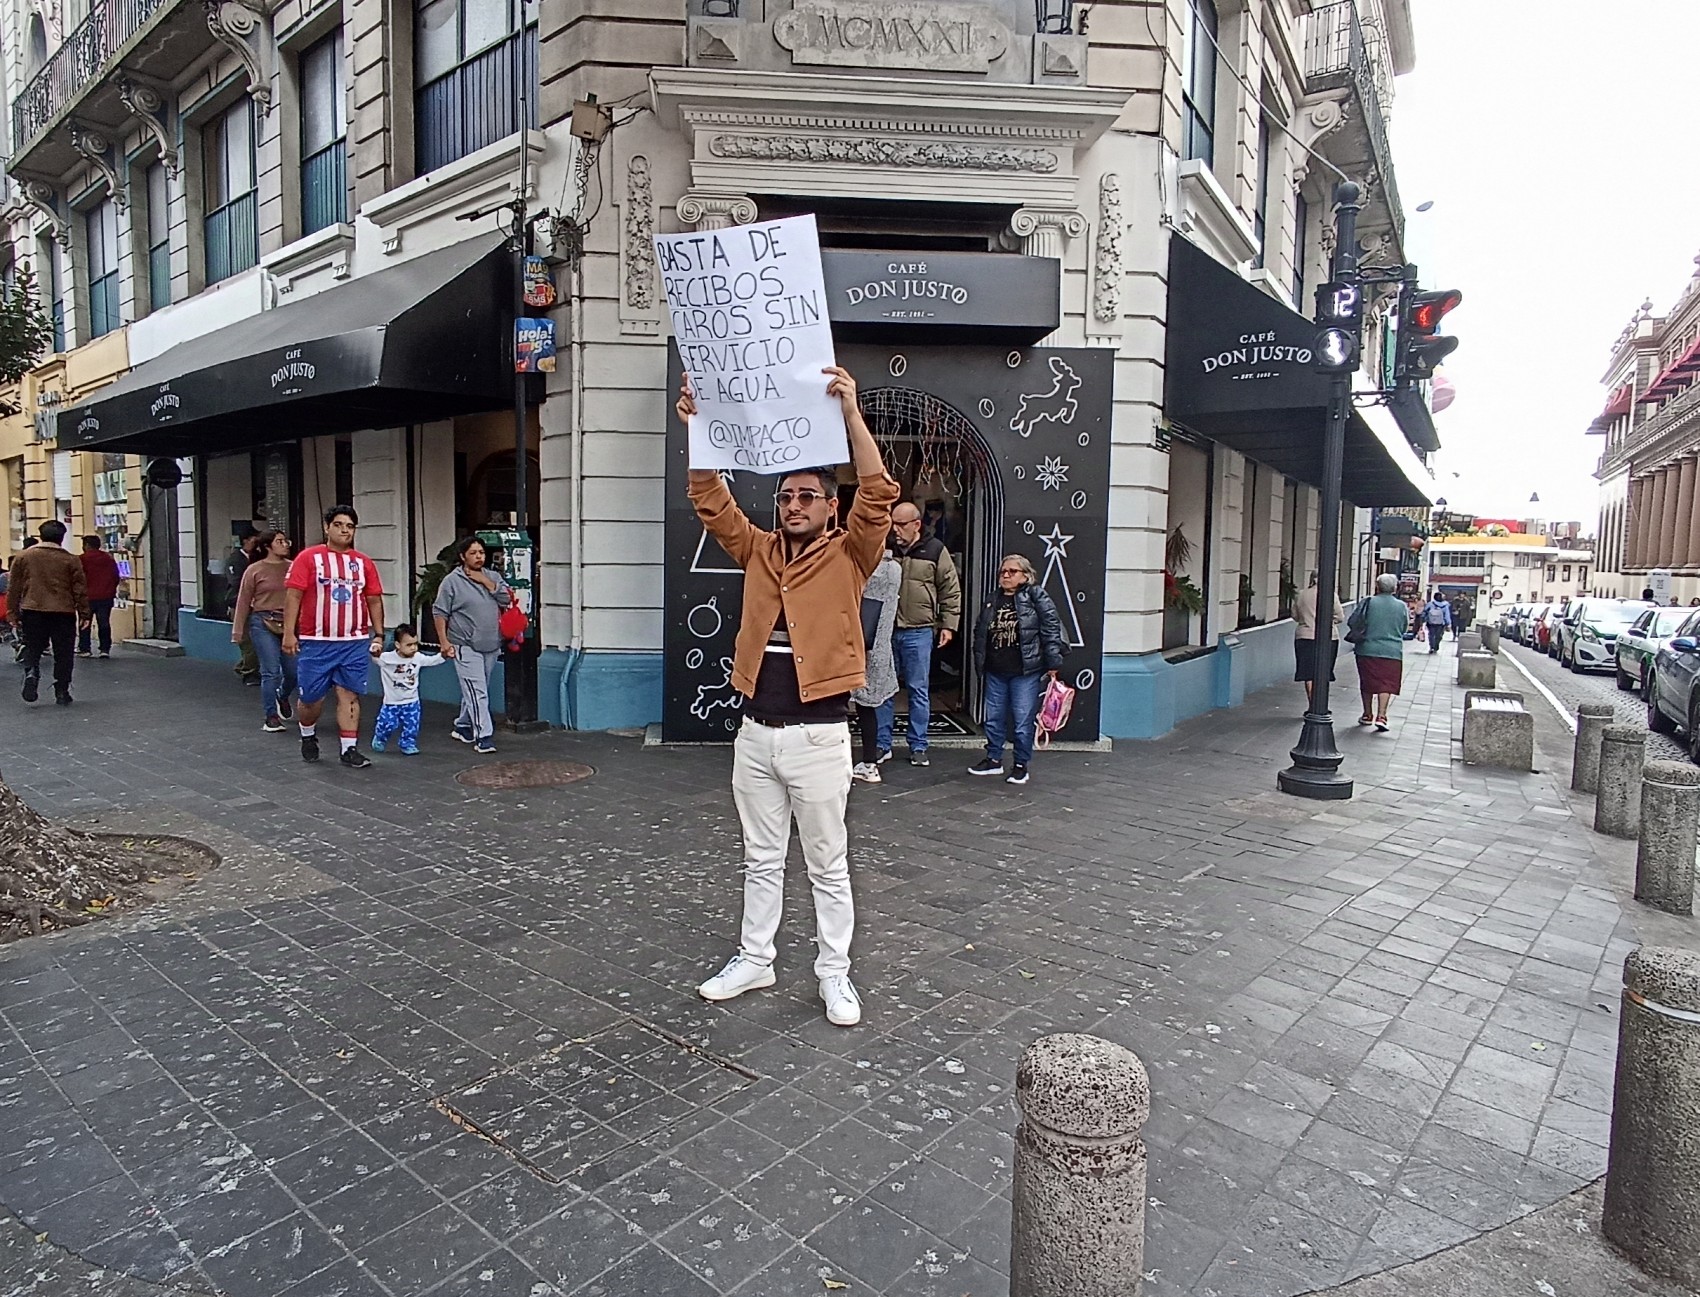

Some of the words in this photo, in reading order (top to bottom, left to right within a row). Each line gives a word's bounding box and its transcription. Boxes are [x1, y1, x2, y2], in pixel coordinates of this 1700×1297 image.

[657, 234, 730, 272] BASTA
[748, 225, 786, 262] DE
[887, 261, 927, 274] CAFÉ
[665, 265, 784, 308] RECIBOS
[845, 280, 897, 306] DON
[901, 280, 968, 304] JUSTO
[672, 305, 752, 340] CAROS
[764, 289, 820, 330] SIN
[1334, 288, 1355, 318] 12
[518, 323, 553, 342] Hola!
[1239, 330, 1276, 344] CAFÉ
[680, 336, 795, 374] SERVICIO
[1202, 348, 1247, 373] DON
[1250, 345, 1312, 365] JUSTO
[271, 364, 289, 388] DON
[289, 362, 316, 380] JUSTO
[717, 373, 780, 403] AGUA
[708, 416, 811, 449] @IMPACTO
[734, 445, 801, 467] CIVICO
